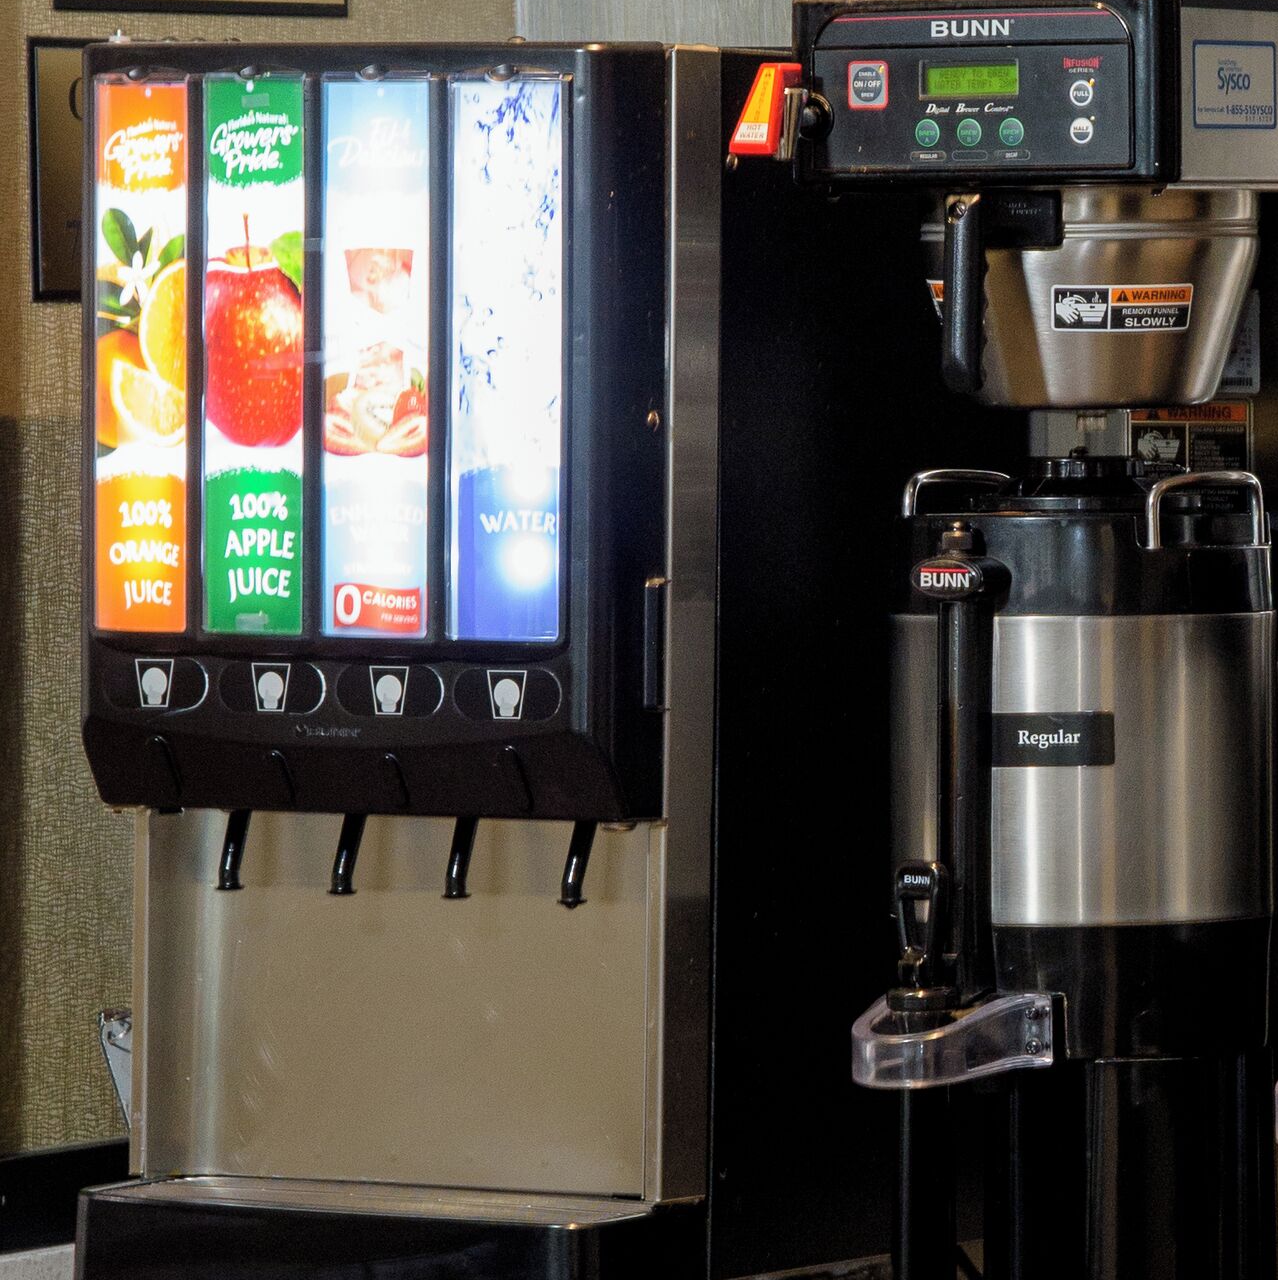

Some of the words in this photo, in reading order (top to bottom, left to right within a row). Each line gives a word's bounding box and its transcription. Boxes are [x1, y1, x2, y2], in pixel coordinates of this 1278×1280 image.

[931, 19, 1010, 38] BUNN
[1217, 66, 1251, 95] Sysco
[1132, 290, 1186, 300] WARNING
[1125, 317, 1176, 327] SLOWLY
[118, 499, 173, 528] 100%
[229, 491, 288, 521] 100%
[480, 511, 557, 535] WATER
[109, 539, 179, 568] ORANGE
[224, 528, 295, 559] APPLE
[124, 579, 173, 610] JUICE
[228, 567, 291, 603] JUICE
[920, 572, 970, 588] BUNN
[336, 584, 361, 625] 0
[363, 591, 417, 610] CALORIES
[1017, 729, 1081, 749] Regular
[903, 874, 930, 885] BUNN
